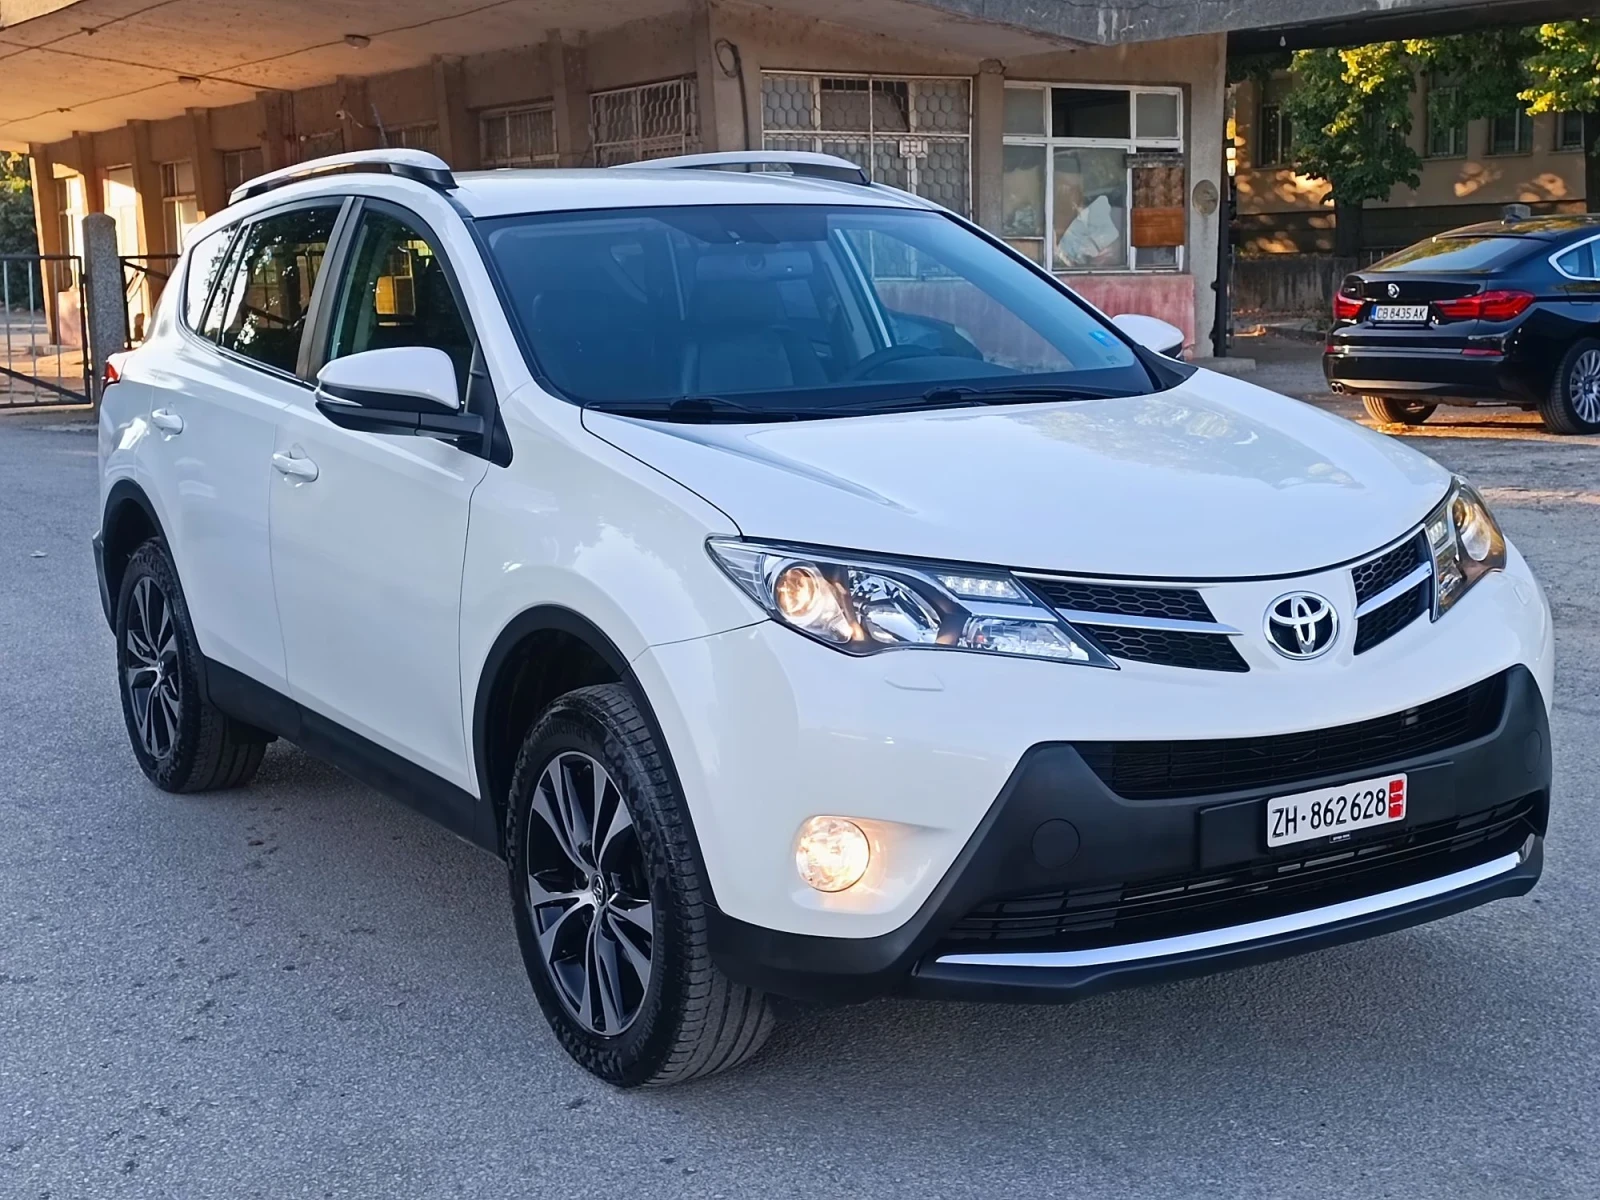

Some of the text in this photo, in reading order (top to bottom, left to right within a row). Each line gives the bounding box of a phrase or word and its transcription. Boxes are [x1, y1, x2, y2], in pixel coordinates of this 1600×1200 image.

[1376, 307, 1426, 319] CB 8435 AK
